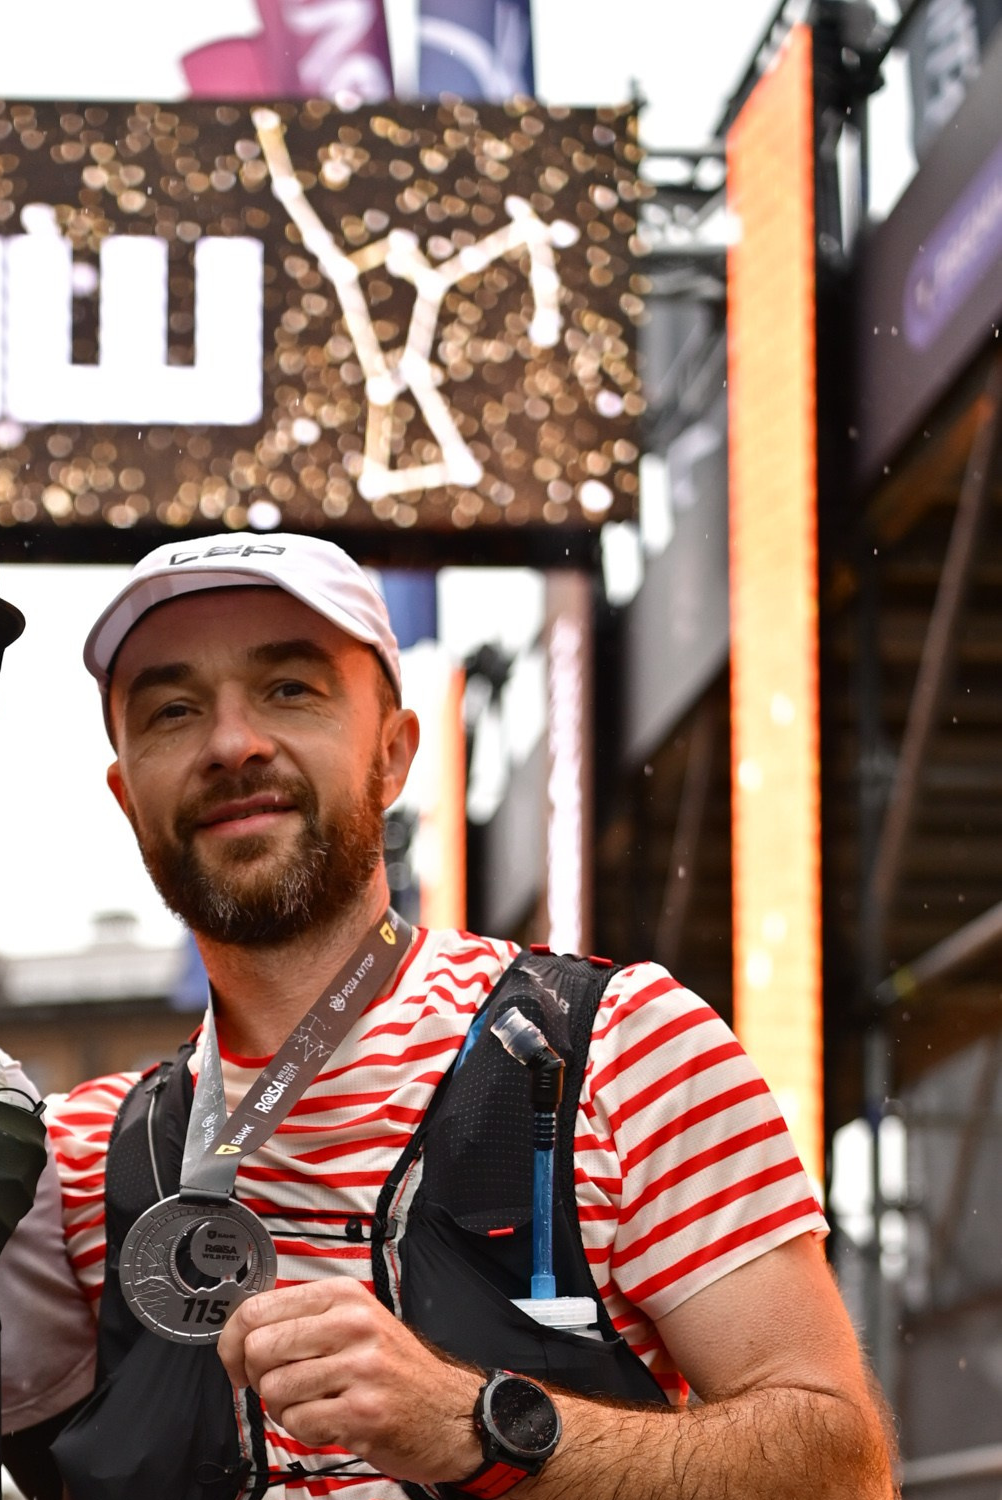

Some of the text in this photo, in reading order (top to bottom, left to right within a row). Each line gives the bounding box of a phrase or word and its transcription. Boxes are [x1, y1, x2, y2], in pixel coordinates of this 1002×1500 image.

[341, 953, 374, 998] РОЗА ХУТОР
[276, 1064, 291, 1080] WILD
[283, 1069, 296, 1084] FEST
[254, 1080, 288, 1114] ROSA
[230, 1123, 255, 1145] БАНК
[204, 1244, 237, 1254] ROSA
[222, 1254, 240, 1262] FEST
[182, 1298, 231, 1325] 115
